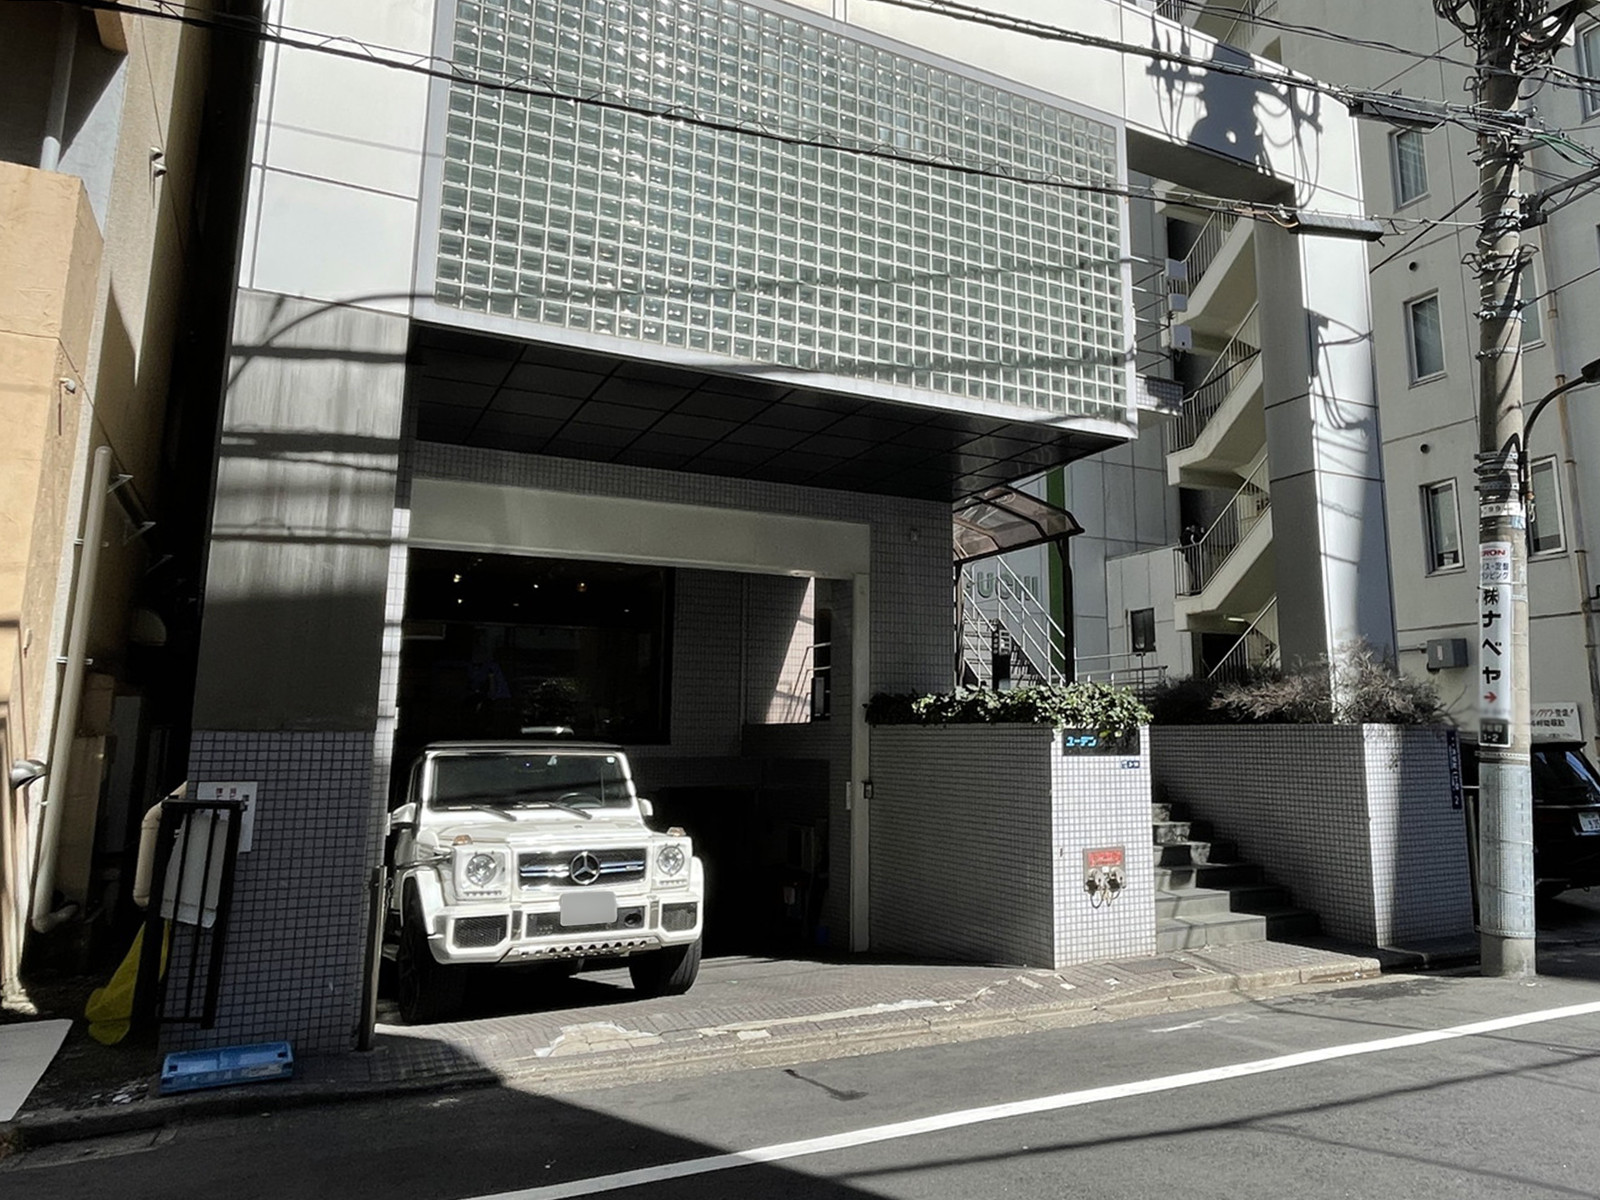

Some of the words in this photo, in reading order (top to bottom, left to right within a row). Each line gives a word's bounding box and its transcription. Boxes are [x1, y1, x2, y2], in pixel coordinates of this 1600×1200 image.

[1482, 587, 1502, 685] 株ナベヤ
[1065, 735, 1098, 747] ユーデン
